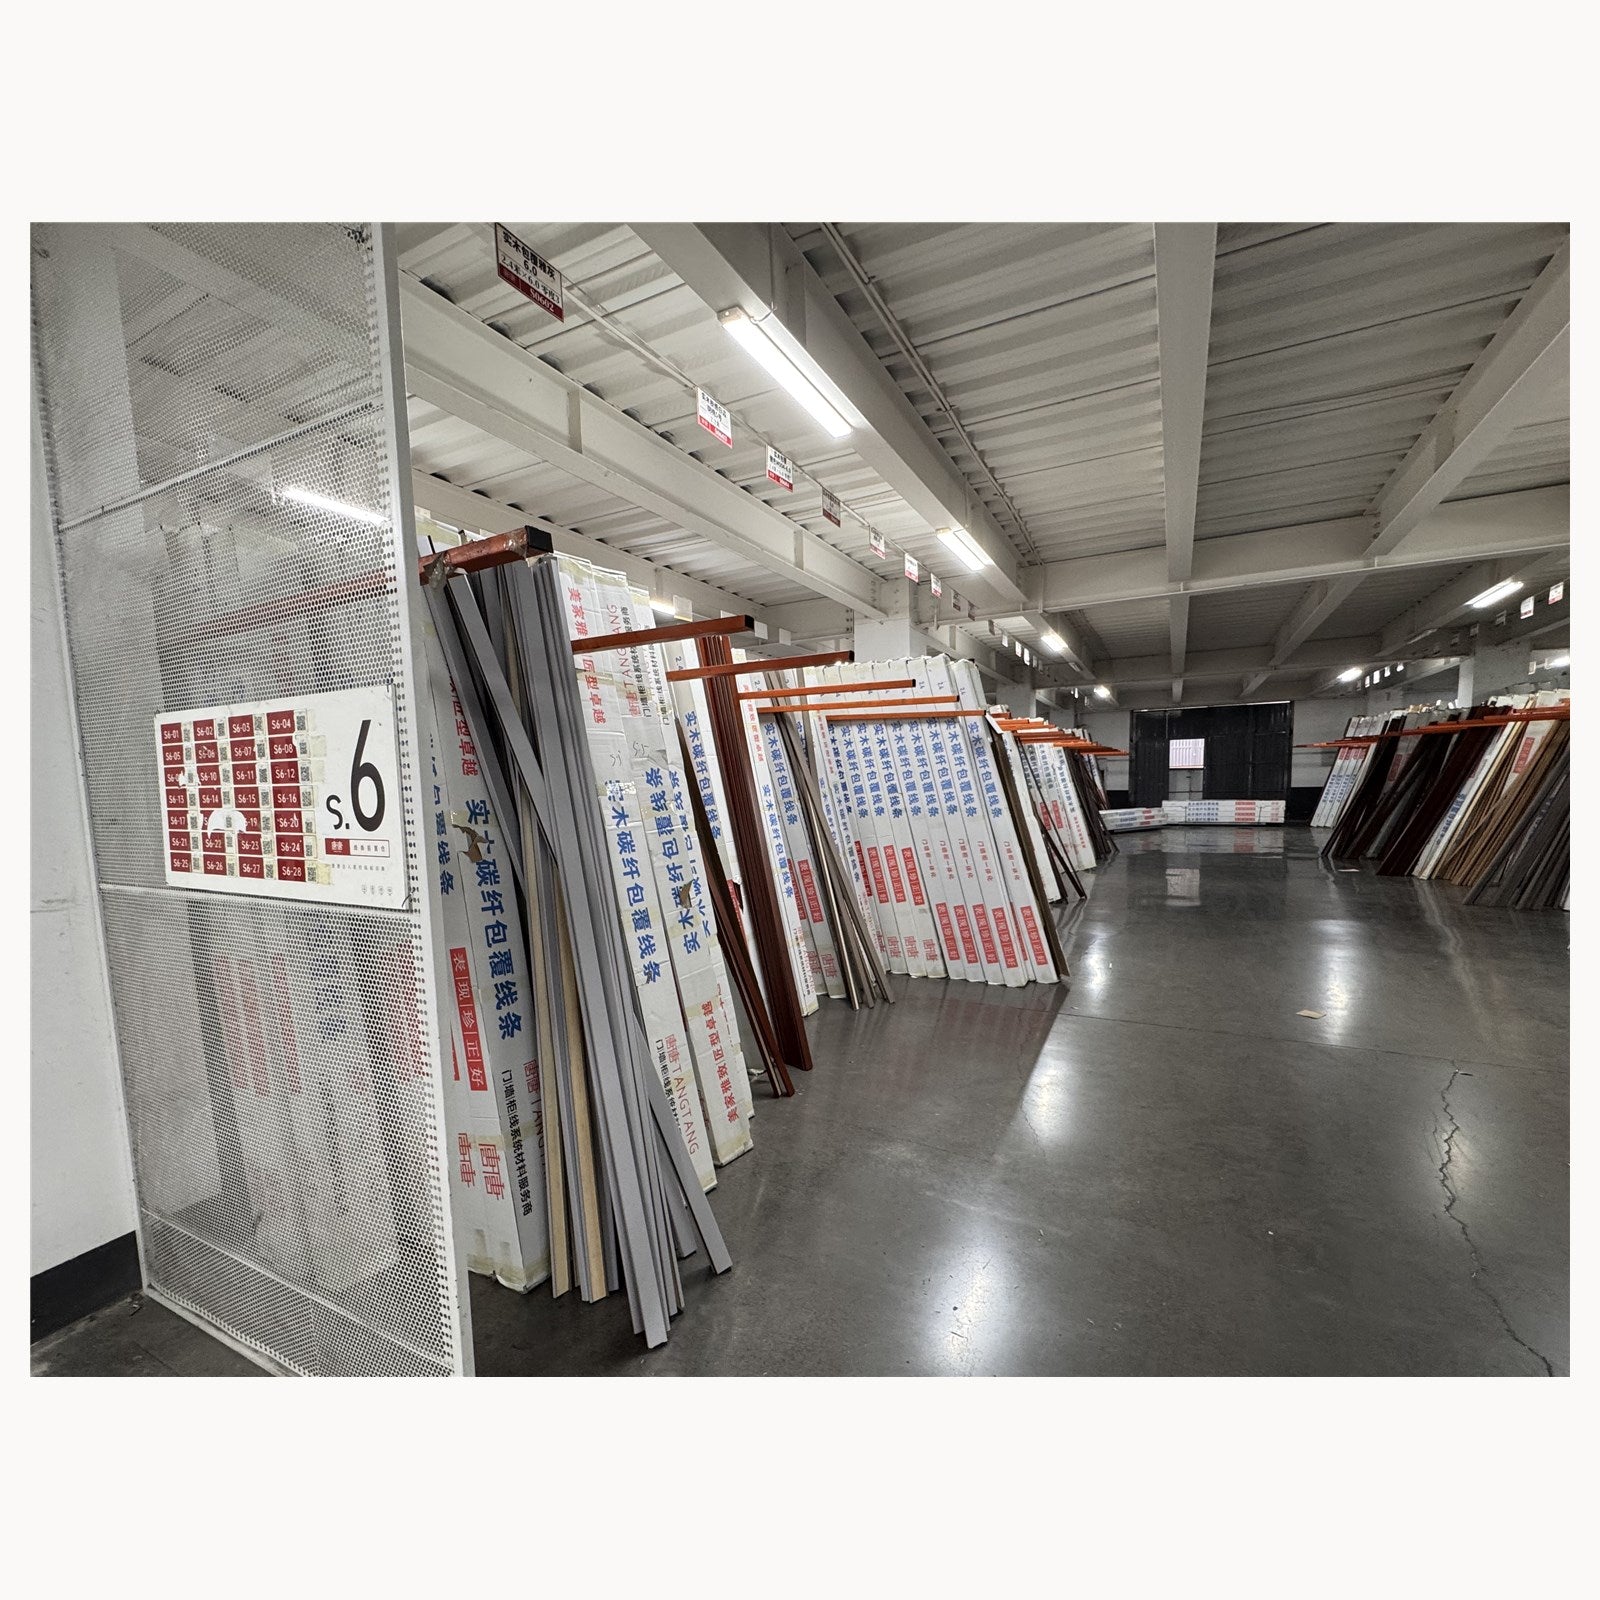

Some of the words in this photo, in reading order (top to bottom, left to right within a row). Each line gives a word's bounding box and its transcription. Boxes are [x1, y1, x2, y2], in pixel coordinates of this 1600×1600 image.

[523, 260, 537, 276] 6.0
[607, 604, 634, 688] TANGANG
[568, 587, 606, 724] 美家雅|匠型卓越
[232, 722, 250, 734] S6-03
[271, 718, 291, 730] S6-04
[163, 730, 179, 740] S6-01
[196, 726, 213, 737] S6-02
[198, 749, 215, 759] S6-06
[234, 746, 252, 757] S6-07
[273, 743, 294, 755] S6-08
[165, 751, 181, 761] S6-05
[857, 722, 885, 816] 实木碳纤包覆线条
[873, 723, 903, 819] 实木碳纤包覆线条
[891, 720, 922, 818] 实木碳纤包覆线条
[908, 720, 939, 818] 实木碳纤包覆线条
[926, 716, 958, 815] 实木碳纤包覆线条
[945, 717, 977, 817] 实木碳纤包覆线条
[968, 721, 1002, 818] 实木碳纤包覆线条
[200, 771, 217, 782] S6-10
[236, 770, 254, 780] S6-11
[275, 768, 295, 779] S6-12
[325, 719, 386, 832] S.6
[684, 711, 721, 839] 实木碳纤包覆线条
[764, 722, 798, 825] 实木碳纤包覆线条
[841, 725, 869, 818] 实木碳纤包覆线条
[167, 773, 180, 783] S6-0
[168, 794, 184, 804] S6-13
[202, 794, 219, 804] S6-14
[238, 793, 256, 804] S6-15
[277, 793, 297, 803] S6-16
[170, 816, 186, 825] S6-17
[244, 817, 258, 827] -19
[279, 817, 299, 828] S6-20
[171, 837, 188, 847] S6-21
[205, 839, 222, 849] S6-22
[241, 840, 260, 851] S6-23
[280, 841, 300, 852] S6-24
[762, 785, 794, 897] 实木碳纤包覆线条
[173, 858, 189, 868] S6-25
[206, 861, 223, 871] S6-26
[242, 863, 260, 874] S6-27
[281, 866, 302, 877] S6-28
[673, 1066, 699, 1155] TANGTANG
